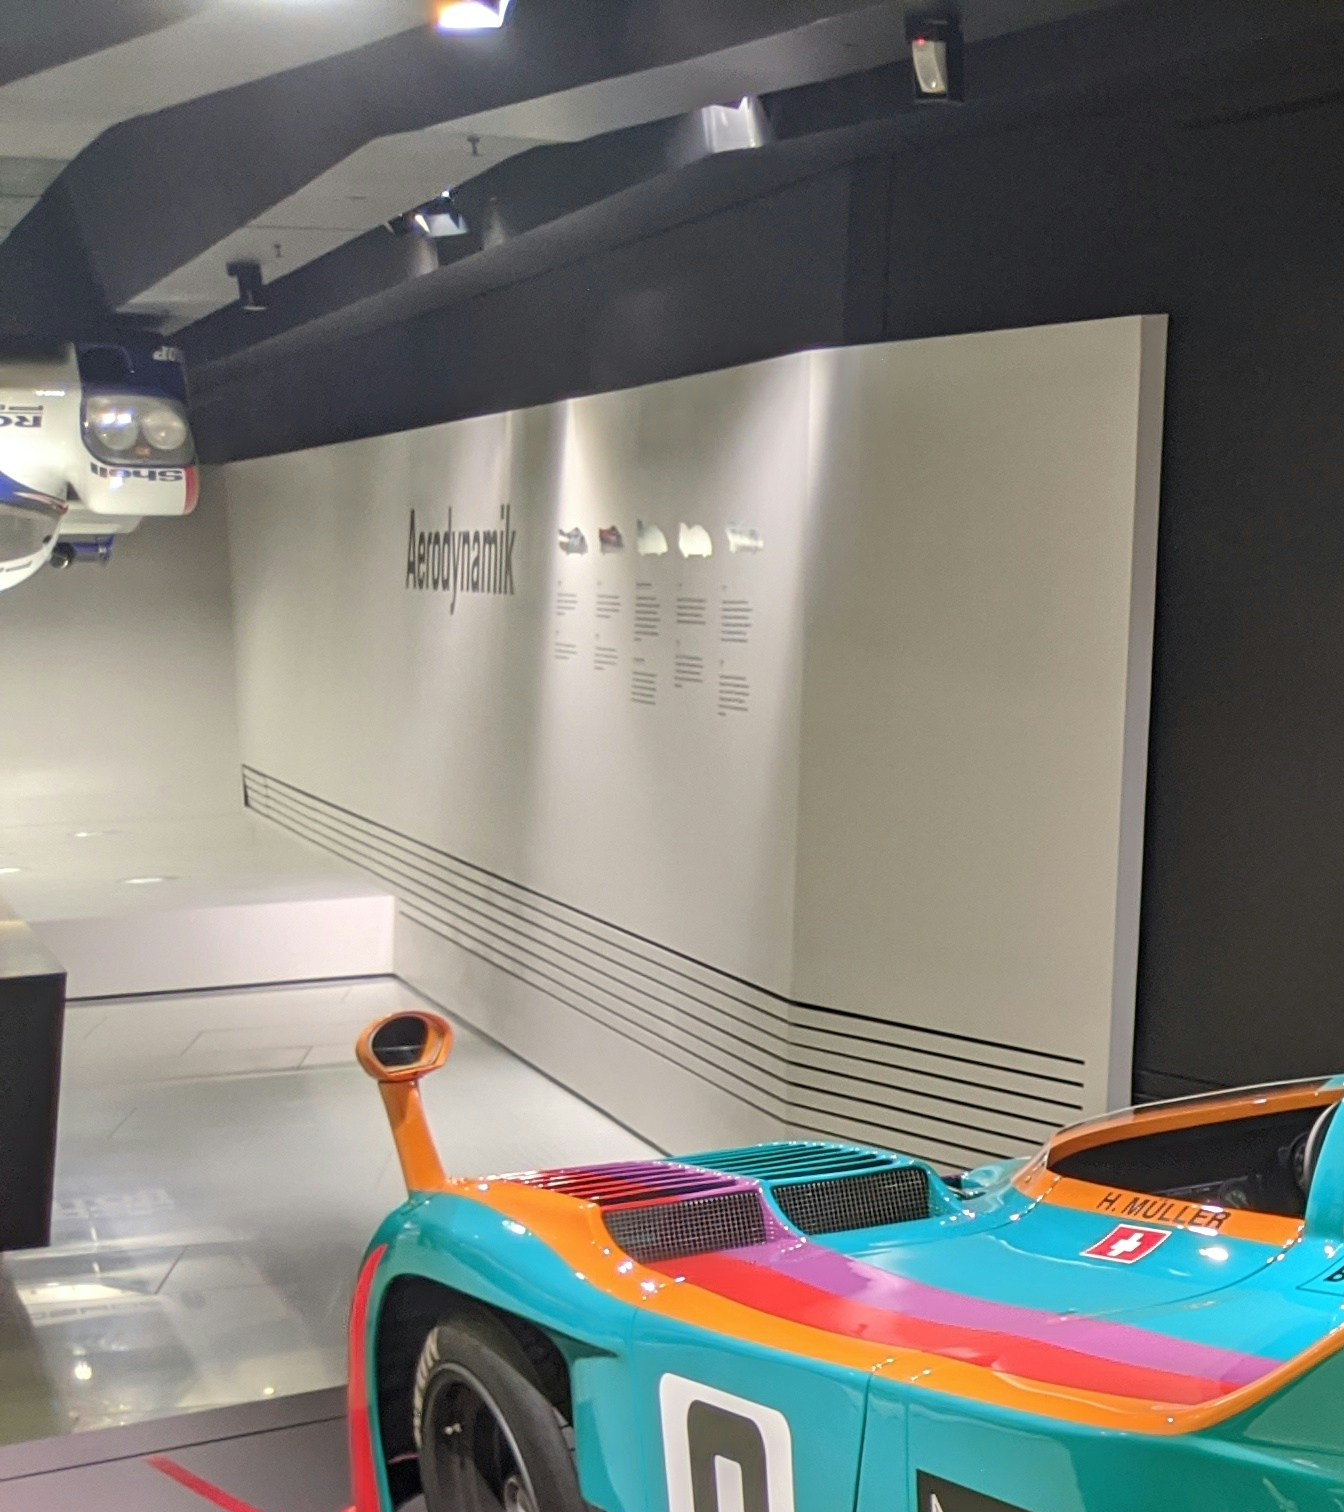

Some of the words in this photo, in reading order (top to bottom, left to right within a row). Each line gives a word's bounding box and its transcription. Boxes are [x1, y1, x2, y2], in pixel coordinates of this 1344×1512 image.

[90, 462, 184, 482] Shell
[405, 504, 516, 615] Aerodynamik
[1096, 1192, 1121, 1211] H.
